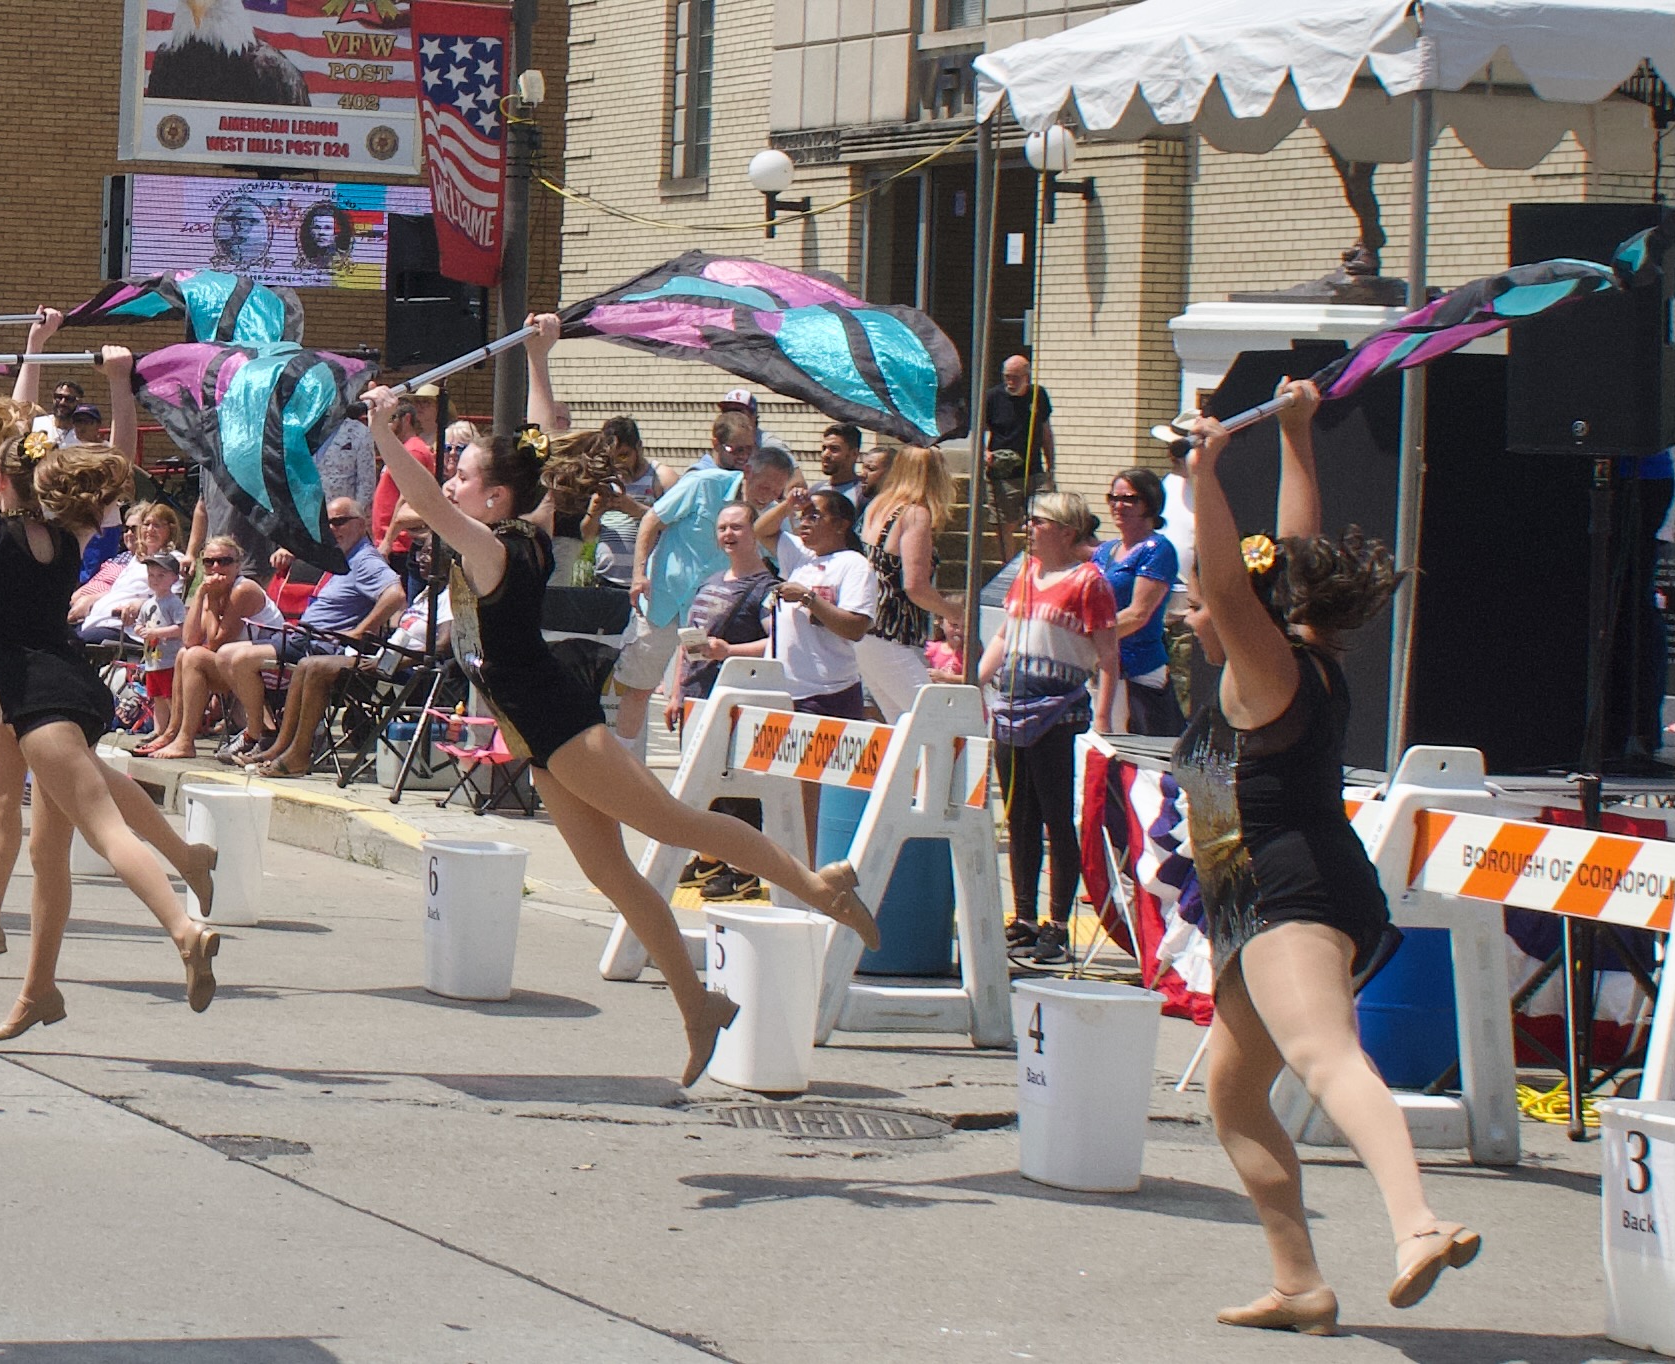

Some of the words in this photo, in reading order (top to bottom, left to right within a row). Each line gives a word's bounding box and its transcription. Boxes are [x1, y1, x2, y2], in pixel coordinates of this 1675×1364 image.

[322, 31, 397, 57] VFW
[328, 62, 393, 84] POST
[338, 93, 380, 111] 402
[219, 116, 290, 135] AMERICAN
[292, 119, 339, 137] LEGION
[206, 136, 245, 152] WEST
[247, 137, 284, 155] HILLS
[286, 139, 322, 156] POST
[323, 141, 350, 158] 924
[431, 166, 497, 247] WELCOME
[753, 723, 798, 763] BOROUGH
[799, 730, 814, 766] OF
[814, 732, 879, 776] CORAOPOLIS
[429, 856, 439, 896] 6
[1463, 845, 1545, 880] BOROUGH
[1549, 858, 1573, 883] OF
[1577, 863, 1675, 900] CORAOPOLI
[715, 924, 726, 970] 5
[1028, 1002, 1044, 1055] 4
[1026, 1066, 1047, 1087] Back
[1626, 1130, 1652, 1193] 3
[1622, 1209, 1657, 1234] Back
